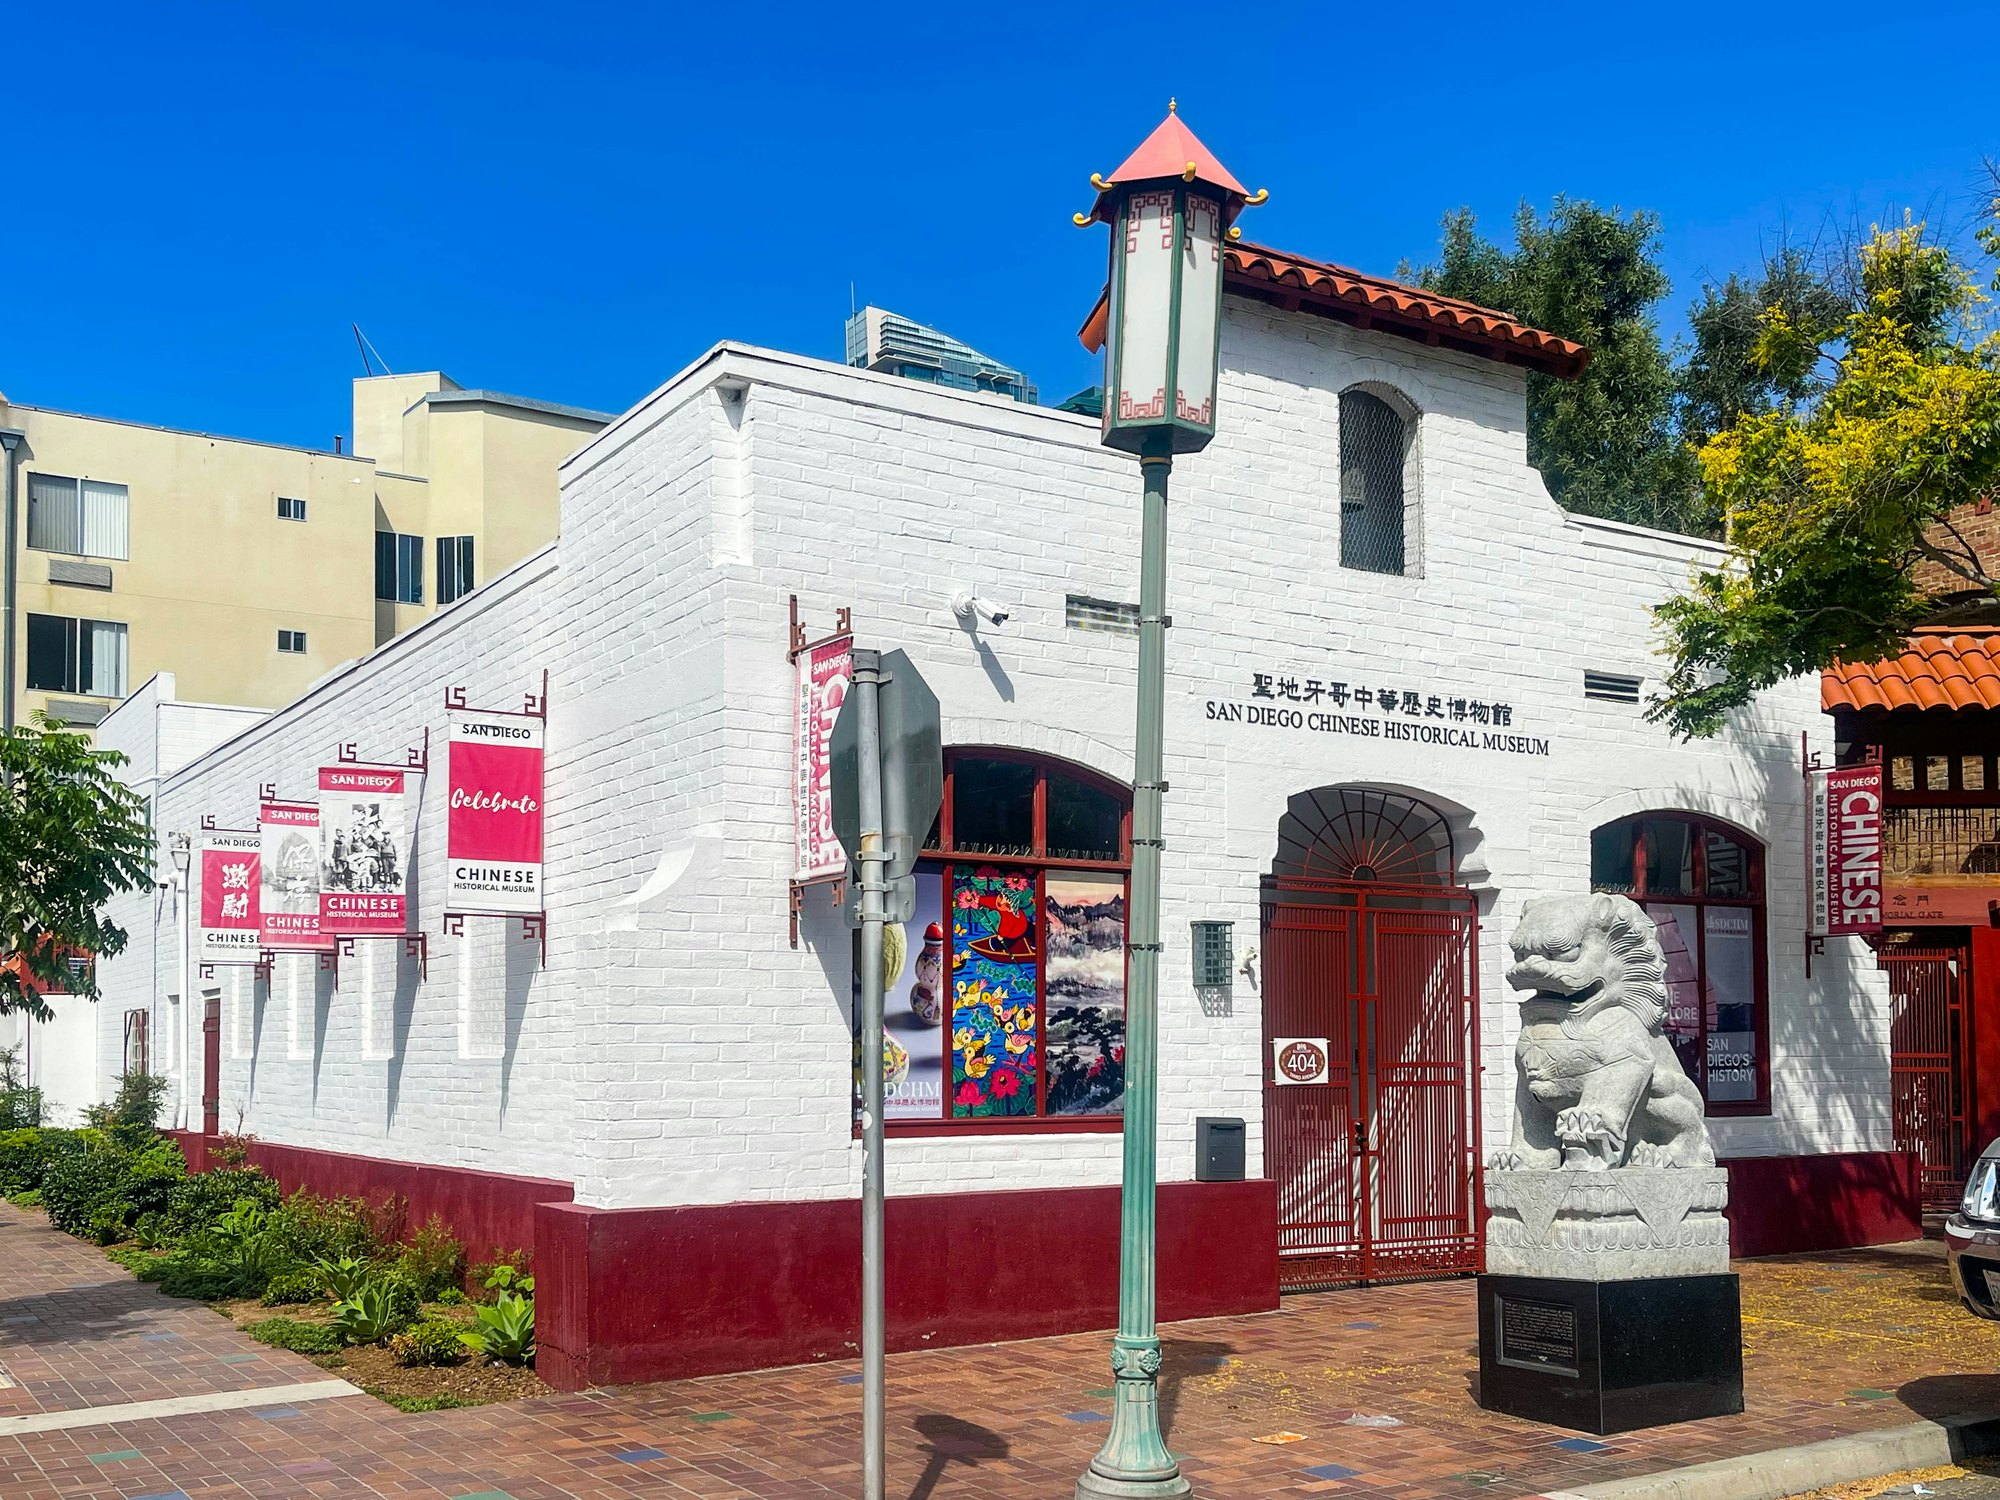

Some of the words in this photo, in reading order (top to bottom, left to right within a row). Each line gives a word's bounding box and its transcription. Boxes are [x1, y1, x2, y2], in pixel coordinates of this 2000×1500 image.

[813, 660, 828, 674] SAN
[829, 653, 850, 670] DIEGO
[462, 724, 489, 737] SAN
[492, 726, 531, 739] DIEGO
[1206, 701, 1242, 722] SAN
[1246, 706, 1303, 729] DIEGO
[1308, 713, 1380, 737] CHINESE
[1384, 721, 1480, 748] HISTORICAL
[1483, 733, 1550, 756] MUSEUM
[331, 775, 355, 785] SAN
[358, 776, 394, 787] DIEGO
[1830, 779, 1849, 789] SAN
[1851, 776, 1879, 788] DIEGO
[451, 788, 539, 814] Celebrate
[271, 810, 293, 820] SAN
[295, 812, 319, 822] DIEG
[1829, 794, 1838, 868] HISTORICAL
[212, 838, 231, 846] SAN
[233, 839, 260, 848] DIEGO
[1841, 790, 1881, 924] CHINESE
[456, 867, 534, 884] CHINESE
[453, 882, 500, 892] HISTORICAL
[501, 884, 535, 893] MUSEUM
[328, 898, 398, 910] CHINESE
[1830, 874, 1840, 925] MUSEUM
[266, 917, 319, 928] CHINES
[1918, 911, 1944, 920] GATE
[207, 933, 260, 943] CHINESE
[1669, 1006, 1698, 1020] LORE
[1706, 1038, 1729, 1051] SAN
[1287, 1054, 1317, 1072] 404
[1707, 1053, 1750, 1067] DIEGO'S
[1707, 1069, 1754, 1082] HISTORY
[884, 1081, 940, 1098] DCHM
